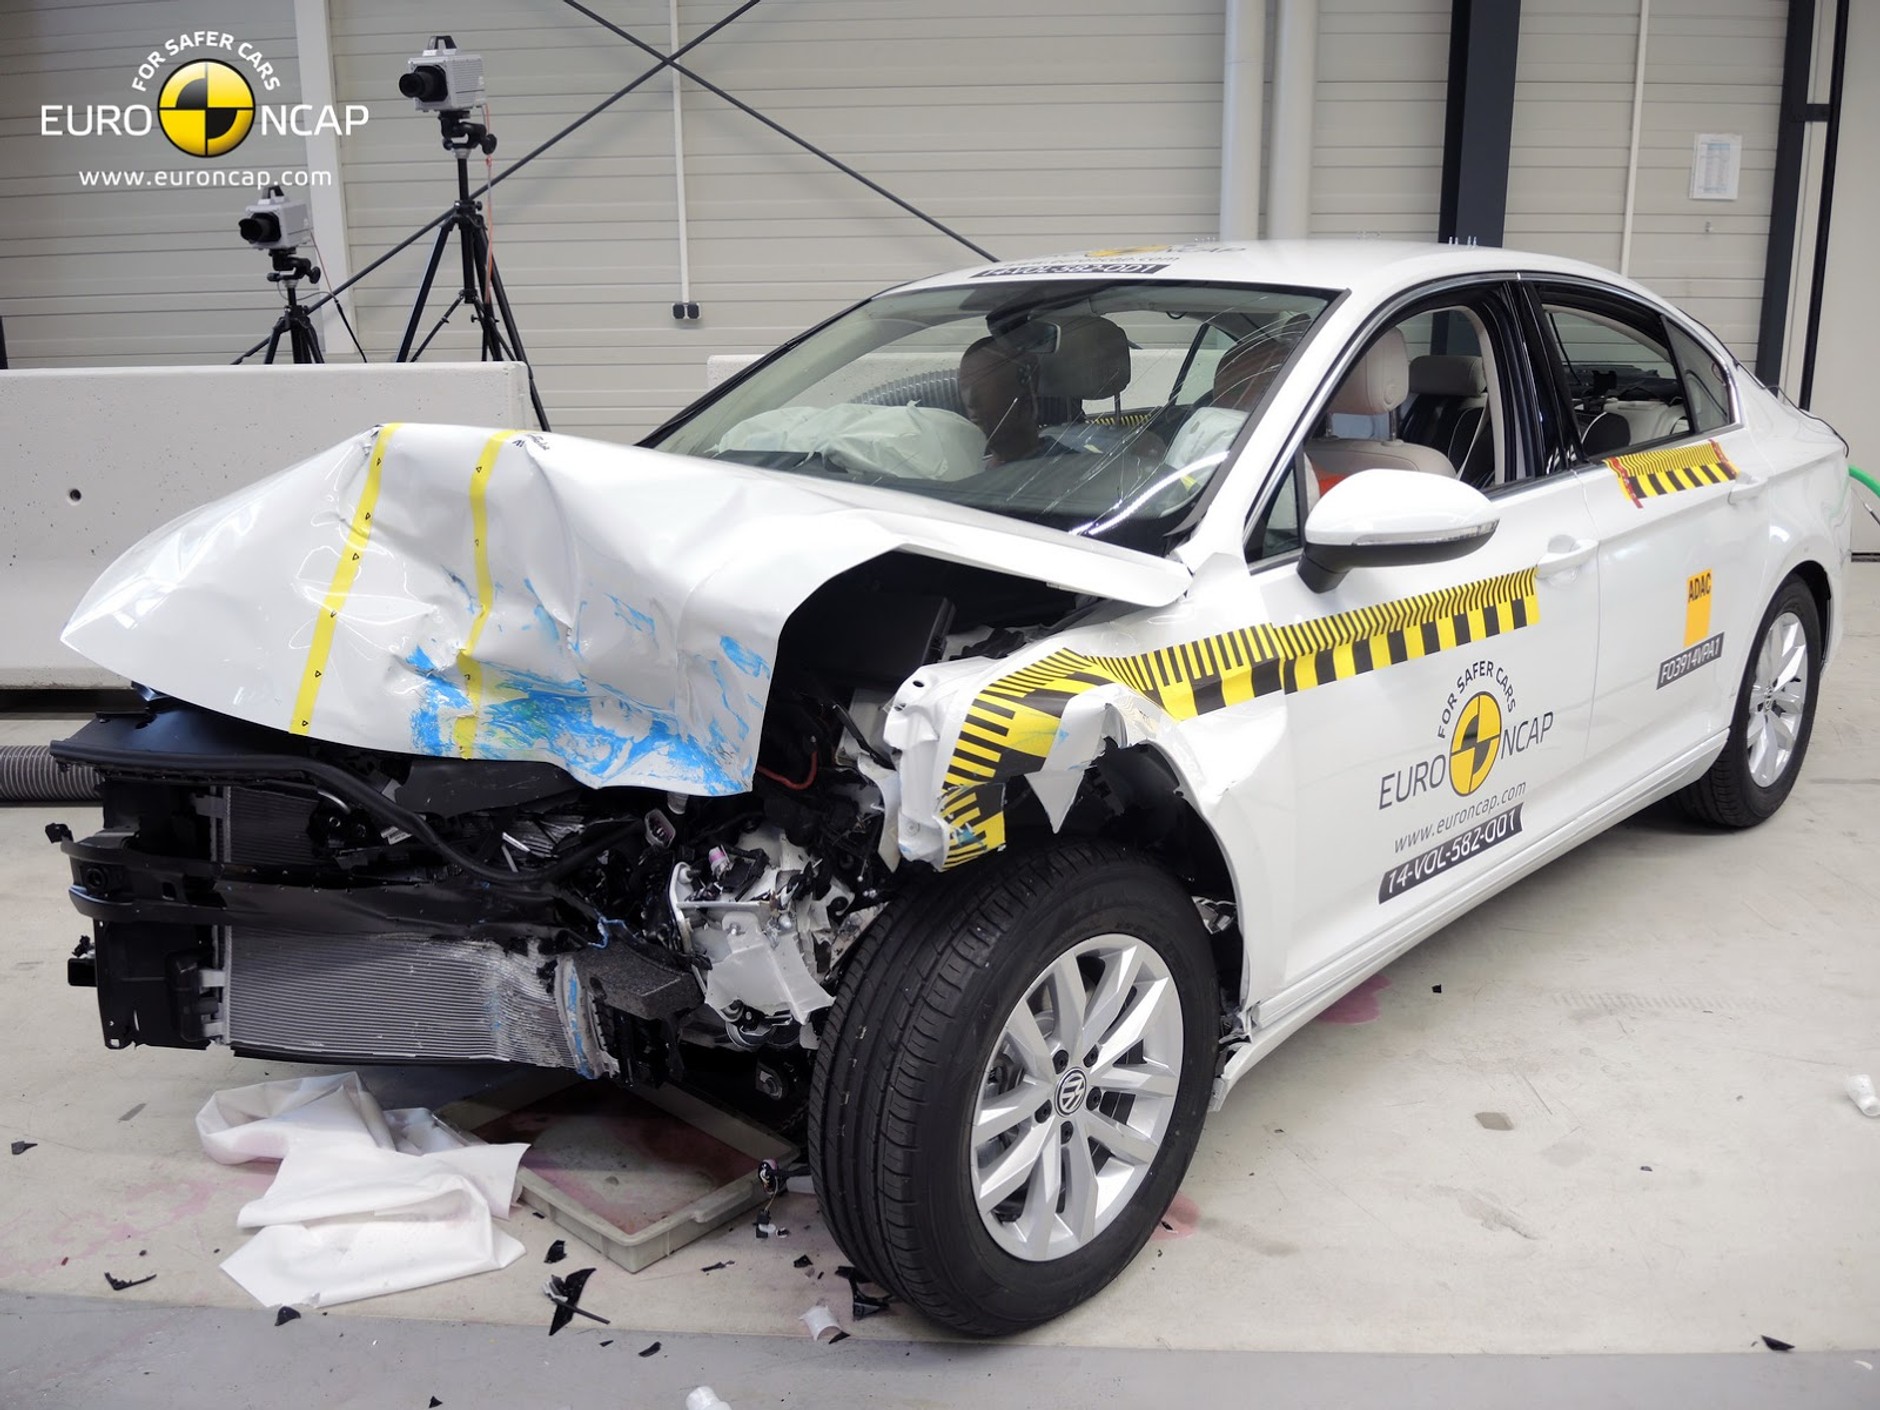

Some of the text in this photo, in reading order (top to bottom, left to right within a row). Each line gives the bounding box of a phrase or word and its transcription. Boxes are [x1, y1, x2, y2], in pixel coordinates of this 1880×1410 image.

[1688, 572, 1711, 603] ADAC
[1438, 661, 1516, 738] FOR SAFER CARS
[1379, 712, 1554, 810] EURO NCAP
[1388, 810, 1516, 894] 14-VOL-582-001
[1394, 782, 1526, 854] www.euroncap.com
